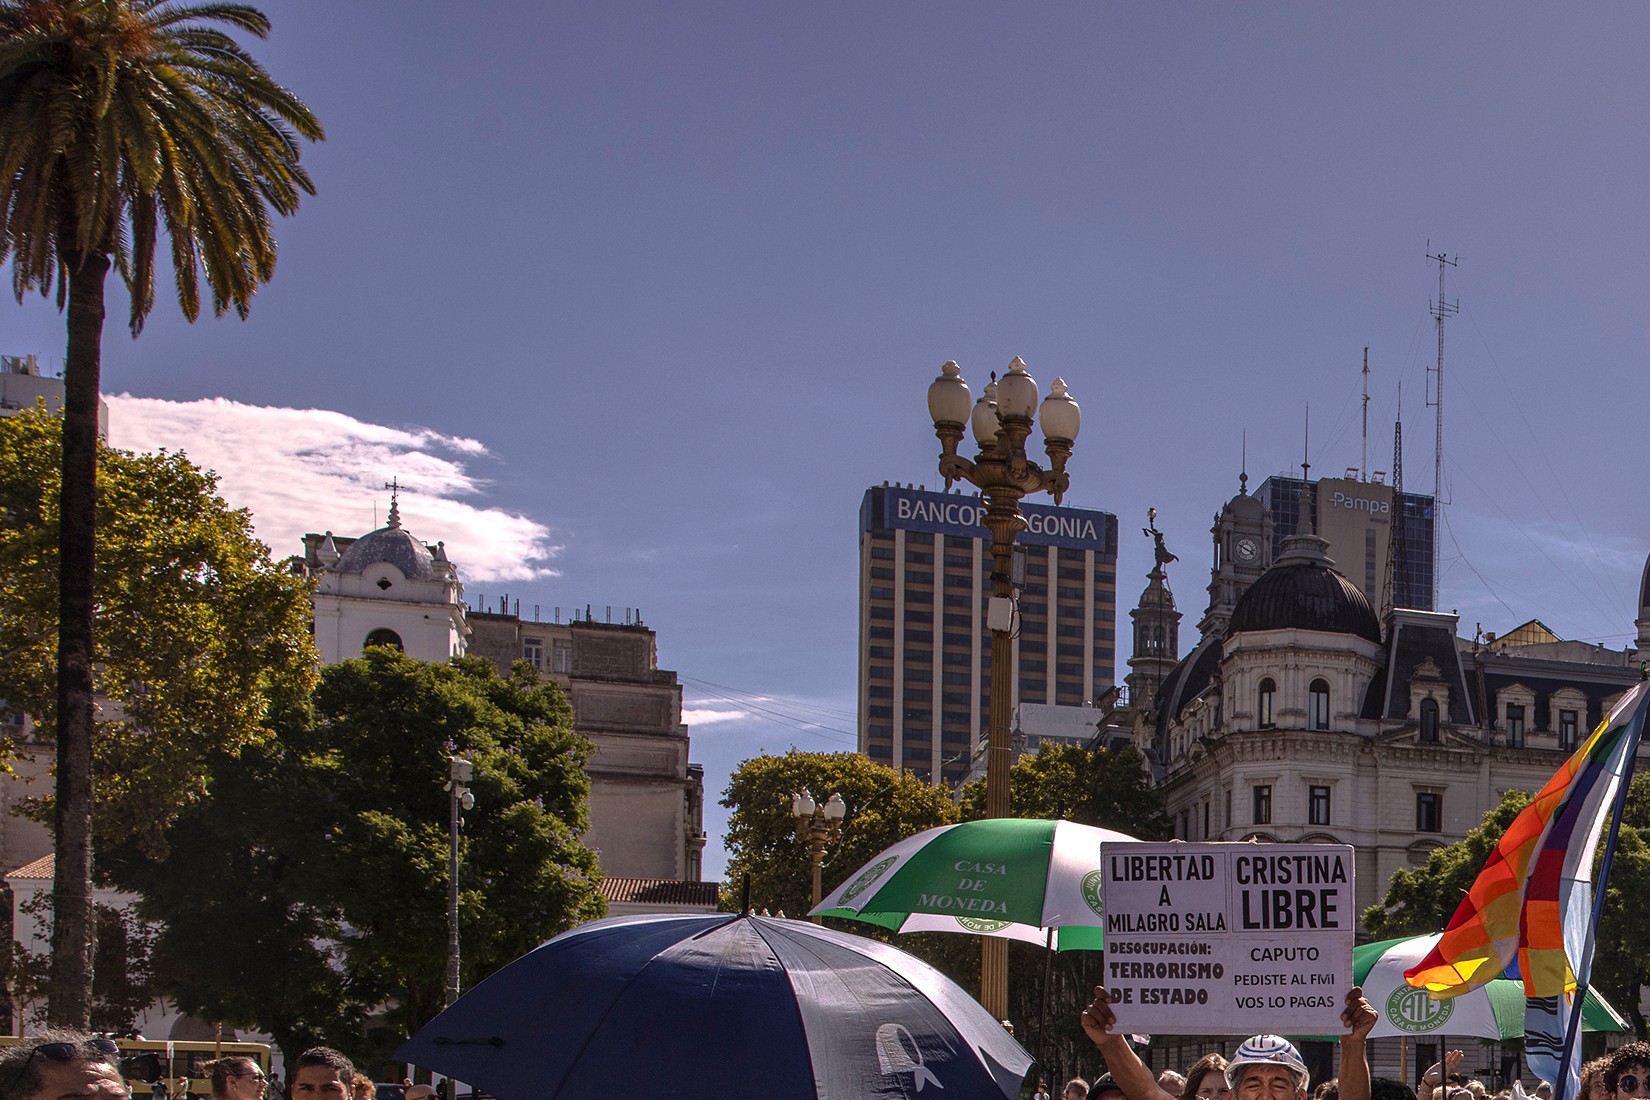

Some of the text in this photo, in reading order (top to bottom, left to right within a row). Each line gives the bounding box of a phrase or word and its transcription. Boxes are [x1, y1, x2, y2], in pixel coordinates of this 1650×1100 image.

[1329, 491, 1389, 515] Pampa
[954, 860, 1007, 876] CASA
[1111, 855, 1215, 881] LIBERTAD
[1236, 855, 1347, 885] CRISTINA
[957, 878, 987, 892] DE
[1086, 873, 1102, 891] JUNT
[917, 893, 1008, 914] MONEDA
[1087, 894, 1104, 913] CAS
[1158, 884, 1171, 906] A
[1242, 889, 1339, 929] LIBRE
[1108, 912, 1226, 932] MILAGRO SALA
[1250, 947, 1319, 962] CAPUTO
[1110, 962, 1224, 979] TERRORISMO
[1234, 974, 1335, 986] PEDISTE AL FMI
[1111, 988, 1208, 1005] DE ESTADO
[1235, 996, 1335, 1009] VOS LO PAGAS
[1391, 986, 1413, 1004] JUNTA
[1401, 992, 1438, 1022] ATE
[1390, 1007, 1405, 1027] CASA
[1420, 1004, 1450, 1031] MONEDA
